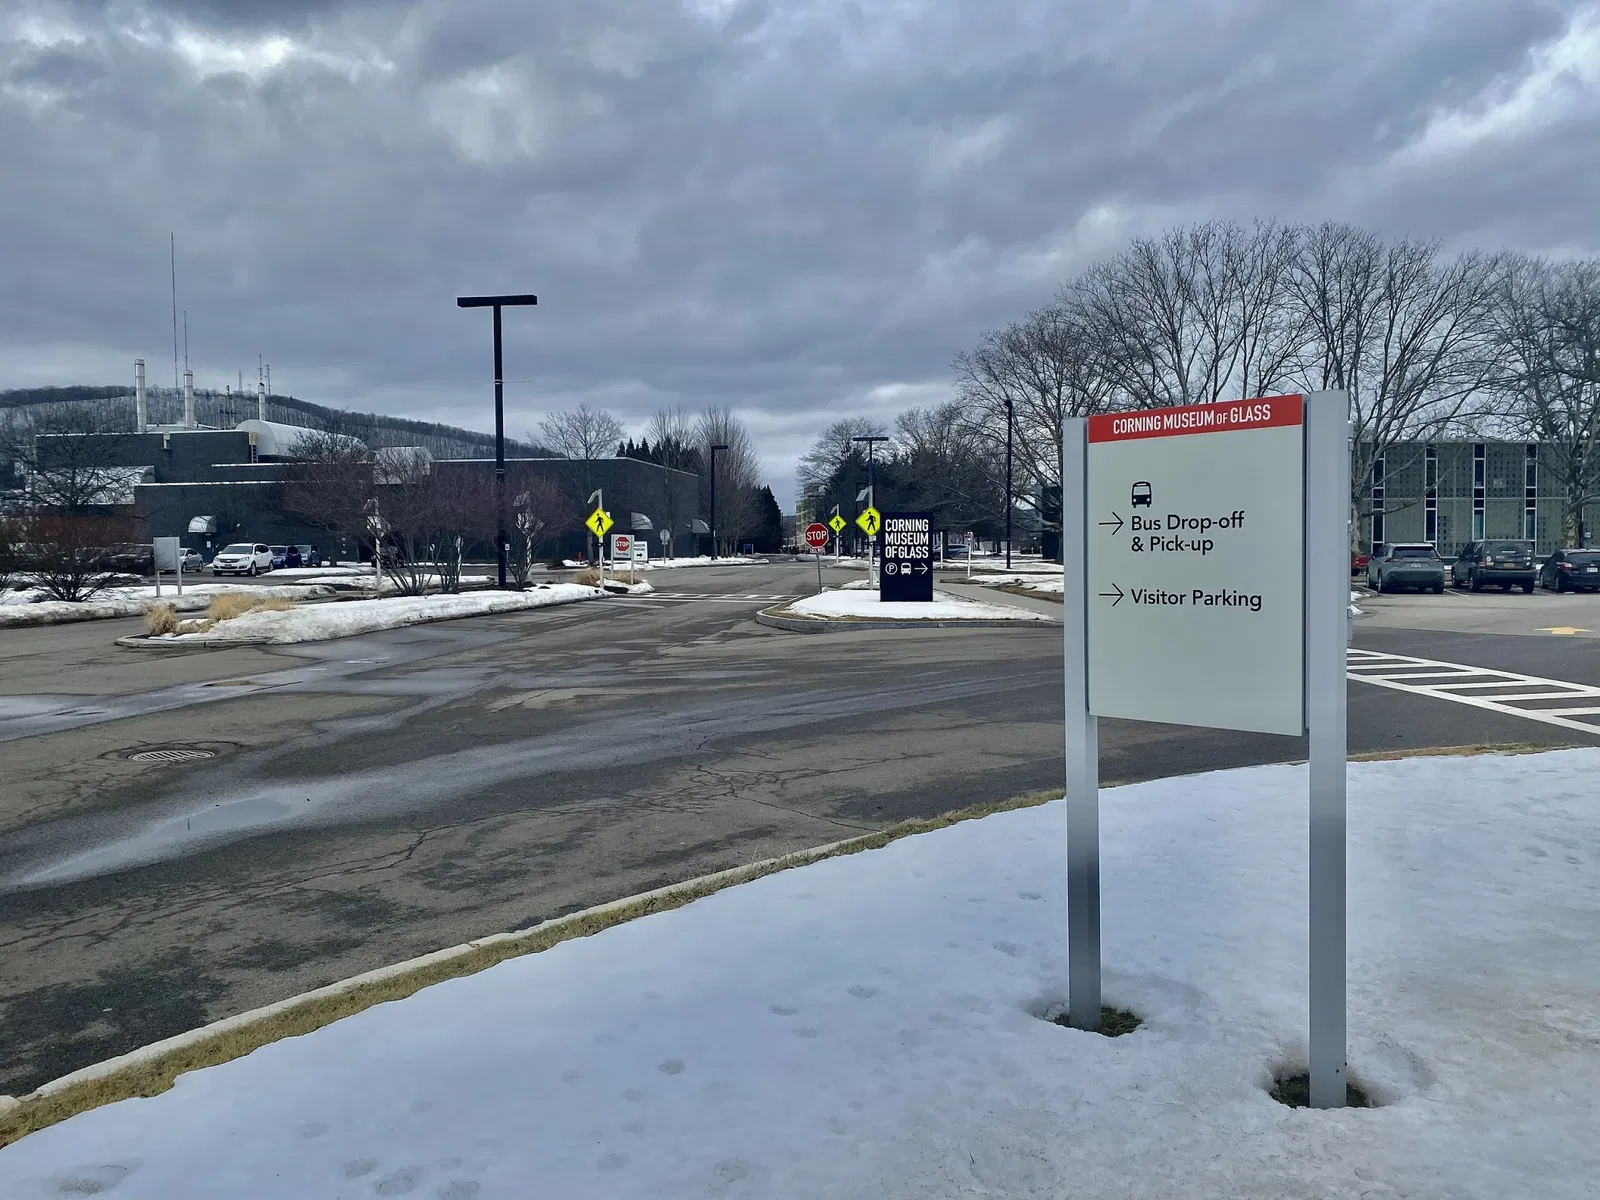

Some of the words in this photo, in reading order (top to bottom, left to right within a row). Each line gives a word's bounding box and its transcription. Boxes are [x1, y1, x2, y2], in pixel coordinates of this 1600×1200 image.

[1113, 415, 1161, 434] CORNING
[1163, 410, 1215, 429] MUSEUM
[1216, 412, 1228, 425] OF
[1230, 403, 1271, 423] GLASS
[885, 518, 929, 532] CORNING
[1131, 515, 1161, 531] Bus
[1167, 510, 1245, 534] Drop-off
[806, 531, 826, 540] STOP
[885, 532, 929, 545] MUSEUM
[885, 545, 898, 559] OF
[898, 545, 929, 559] GLASS
[1131, 536, 1144, 552] &
[1150, 534, 1214, 555] Pick-up
[1131, 589, 1187, 605] Visitor
[1192, 589, 1262, 612] Parking
